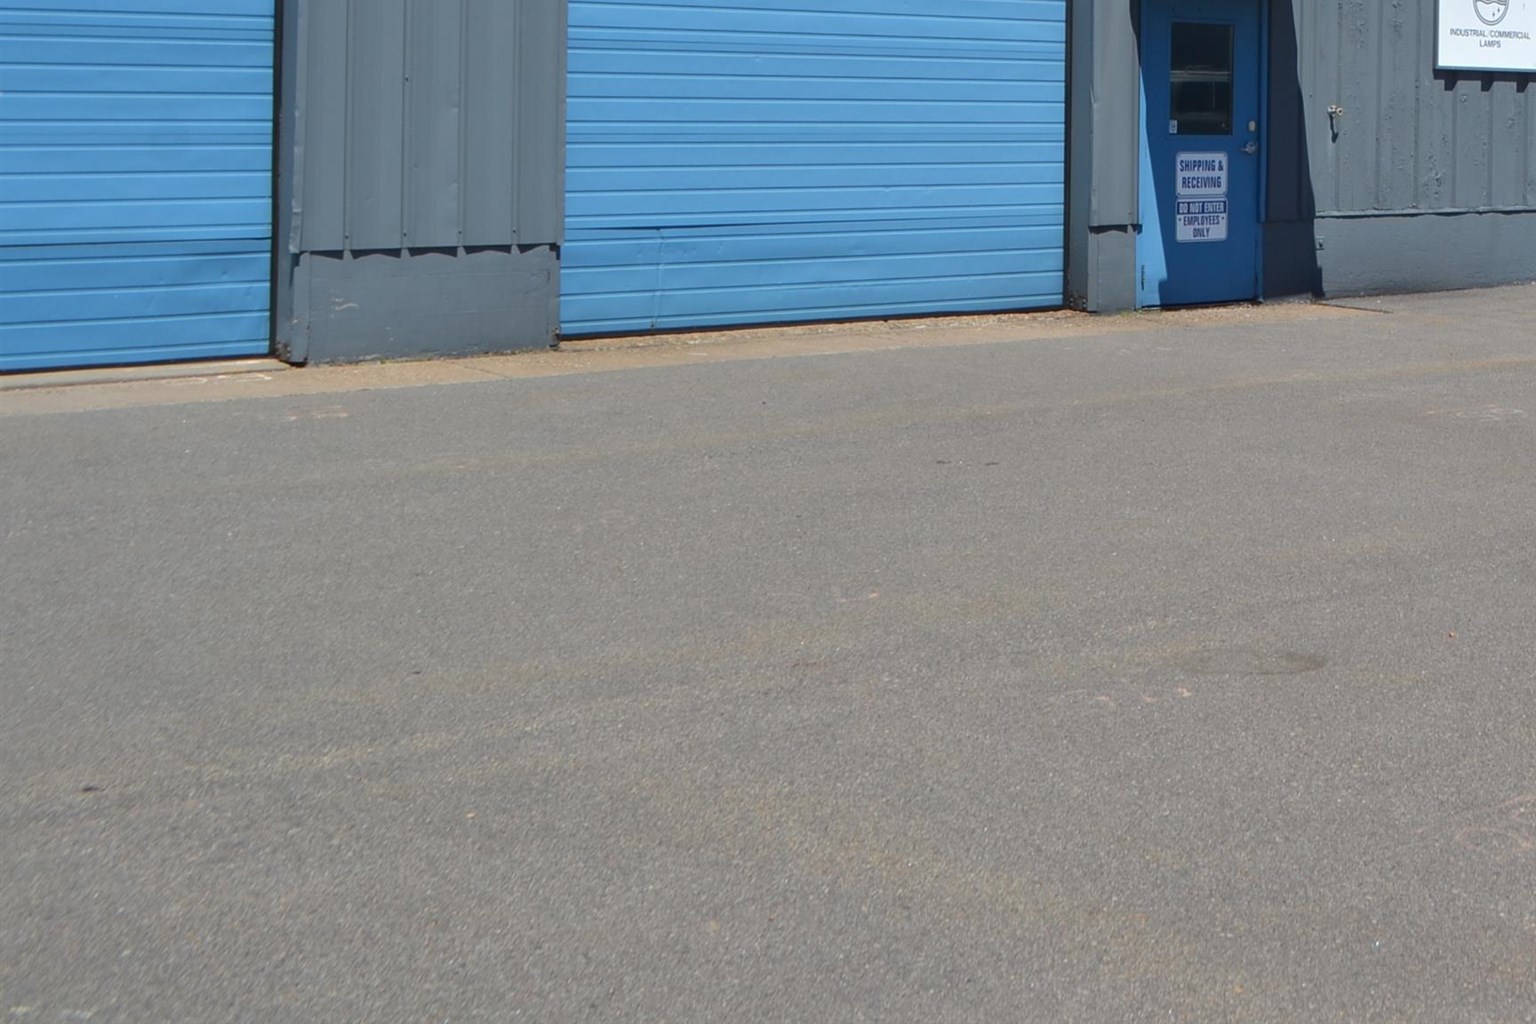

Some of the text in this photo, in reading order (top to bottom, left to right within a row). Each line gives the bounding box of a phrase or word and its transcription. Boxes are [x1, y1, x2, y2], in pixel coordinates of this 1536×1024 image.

[1479, 39, 1501, 48] LAMPS
[1180, 159, 1224, 172] SHIPPING &
[1181, 176, 1222, 189] RECEIVING
[1179, 201, 1225, 214] DO NOT ENTER
[1183, 215, 1220, 226] EMPLOYEES
[1192, 227, 1210, 238] ONLY
